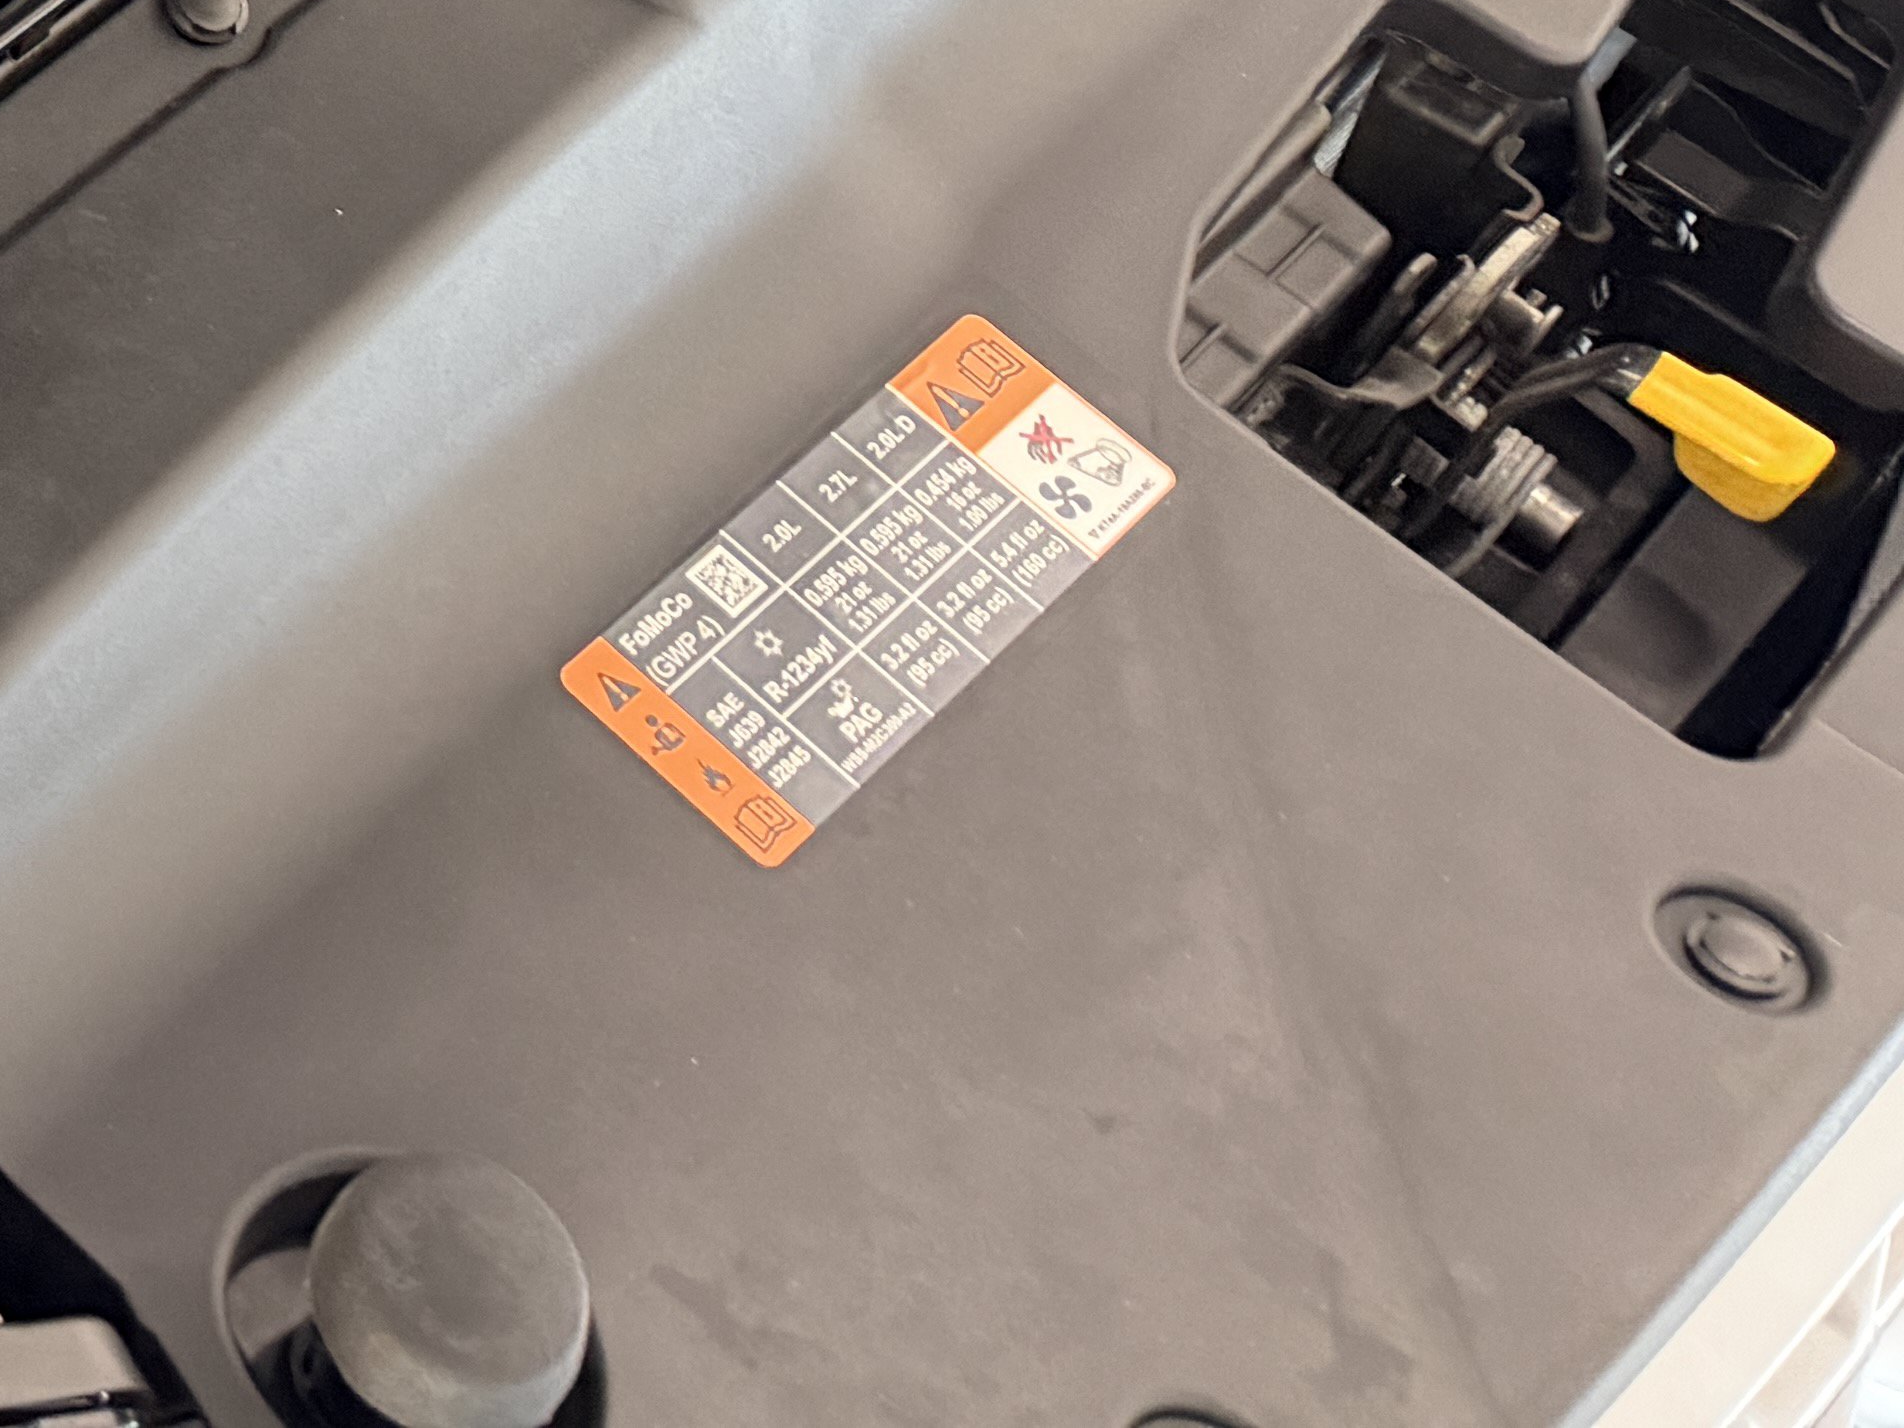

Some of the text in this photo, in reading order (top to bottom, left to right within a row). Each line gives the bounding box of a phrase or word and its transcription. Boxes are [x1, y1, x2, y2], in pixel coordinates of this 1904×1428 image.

[867, 429, 905, 459] 2.0L
[819, 471, 857, 502] 2.7L
[763, 520, 801, 552] 2.0L
[619, 593, 692, 655] FoMoCo
[646, 616, 725, 685] (GWP 4)
[706, 693, 744, 727] SAE
[840, 703, 882, 742] PAG
